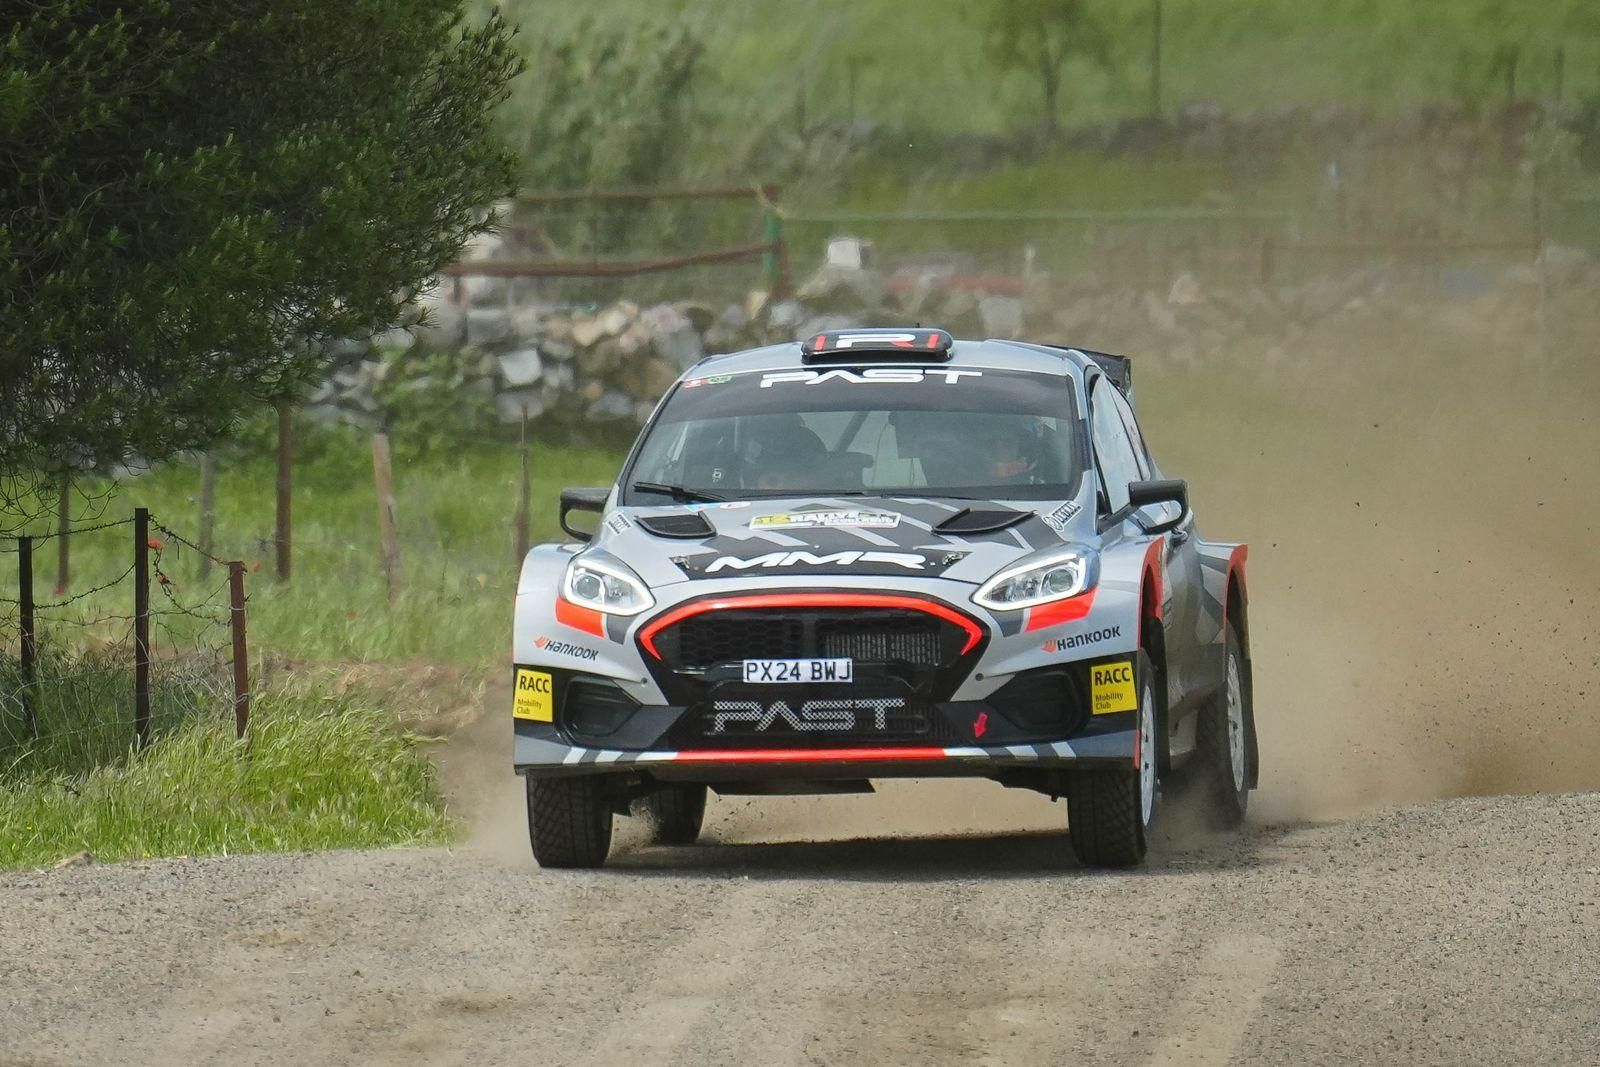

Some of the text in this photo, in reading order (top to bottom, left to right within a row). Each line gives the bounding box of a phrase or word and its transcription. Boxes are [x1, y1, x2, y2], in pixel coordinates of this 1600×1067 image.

[760, 369, 983, 388] PAST
[705, 551, 926, 573] MMR
[746, 661, 850, 681] PX24 BWJ
[1095, 667, 1131, 686] RACC
[519, 675, 550, 693] RACC
[517, 698, 542, 709] Mobility
[1095, 692, 1123, 702] Mobility
[1095, 701, 1111, 710] Club
[516, 706, 530, 715] Club
[714, 699, 905, 733] PAST
